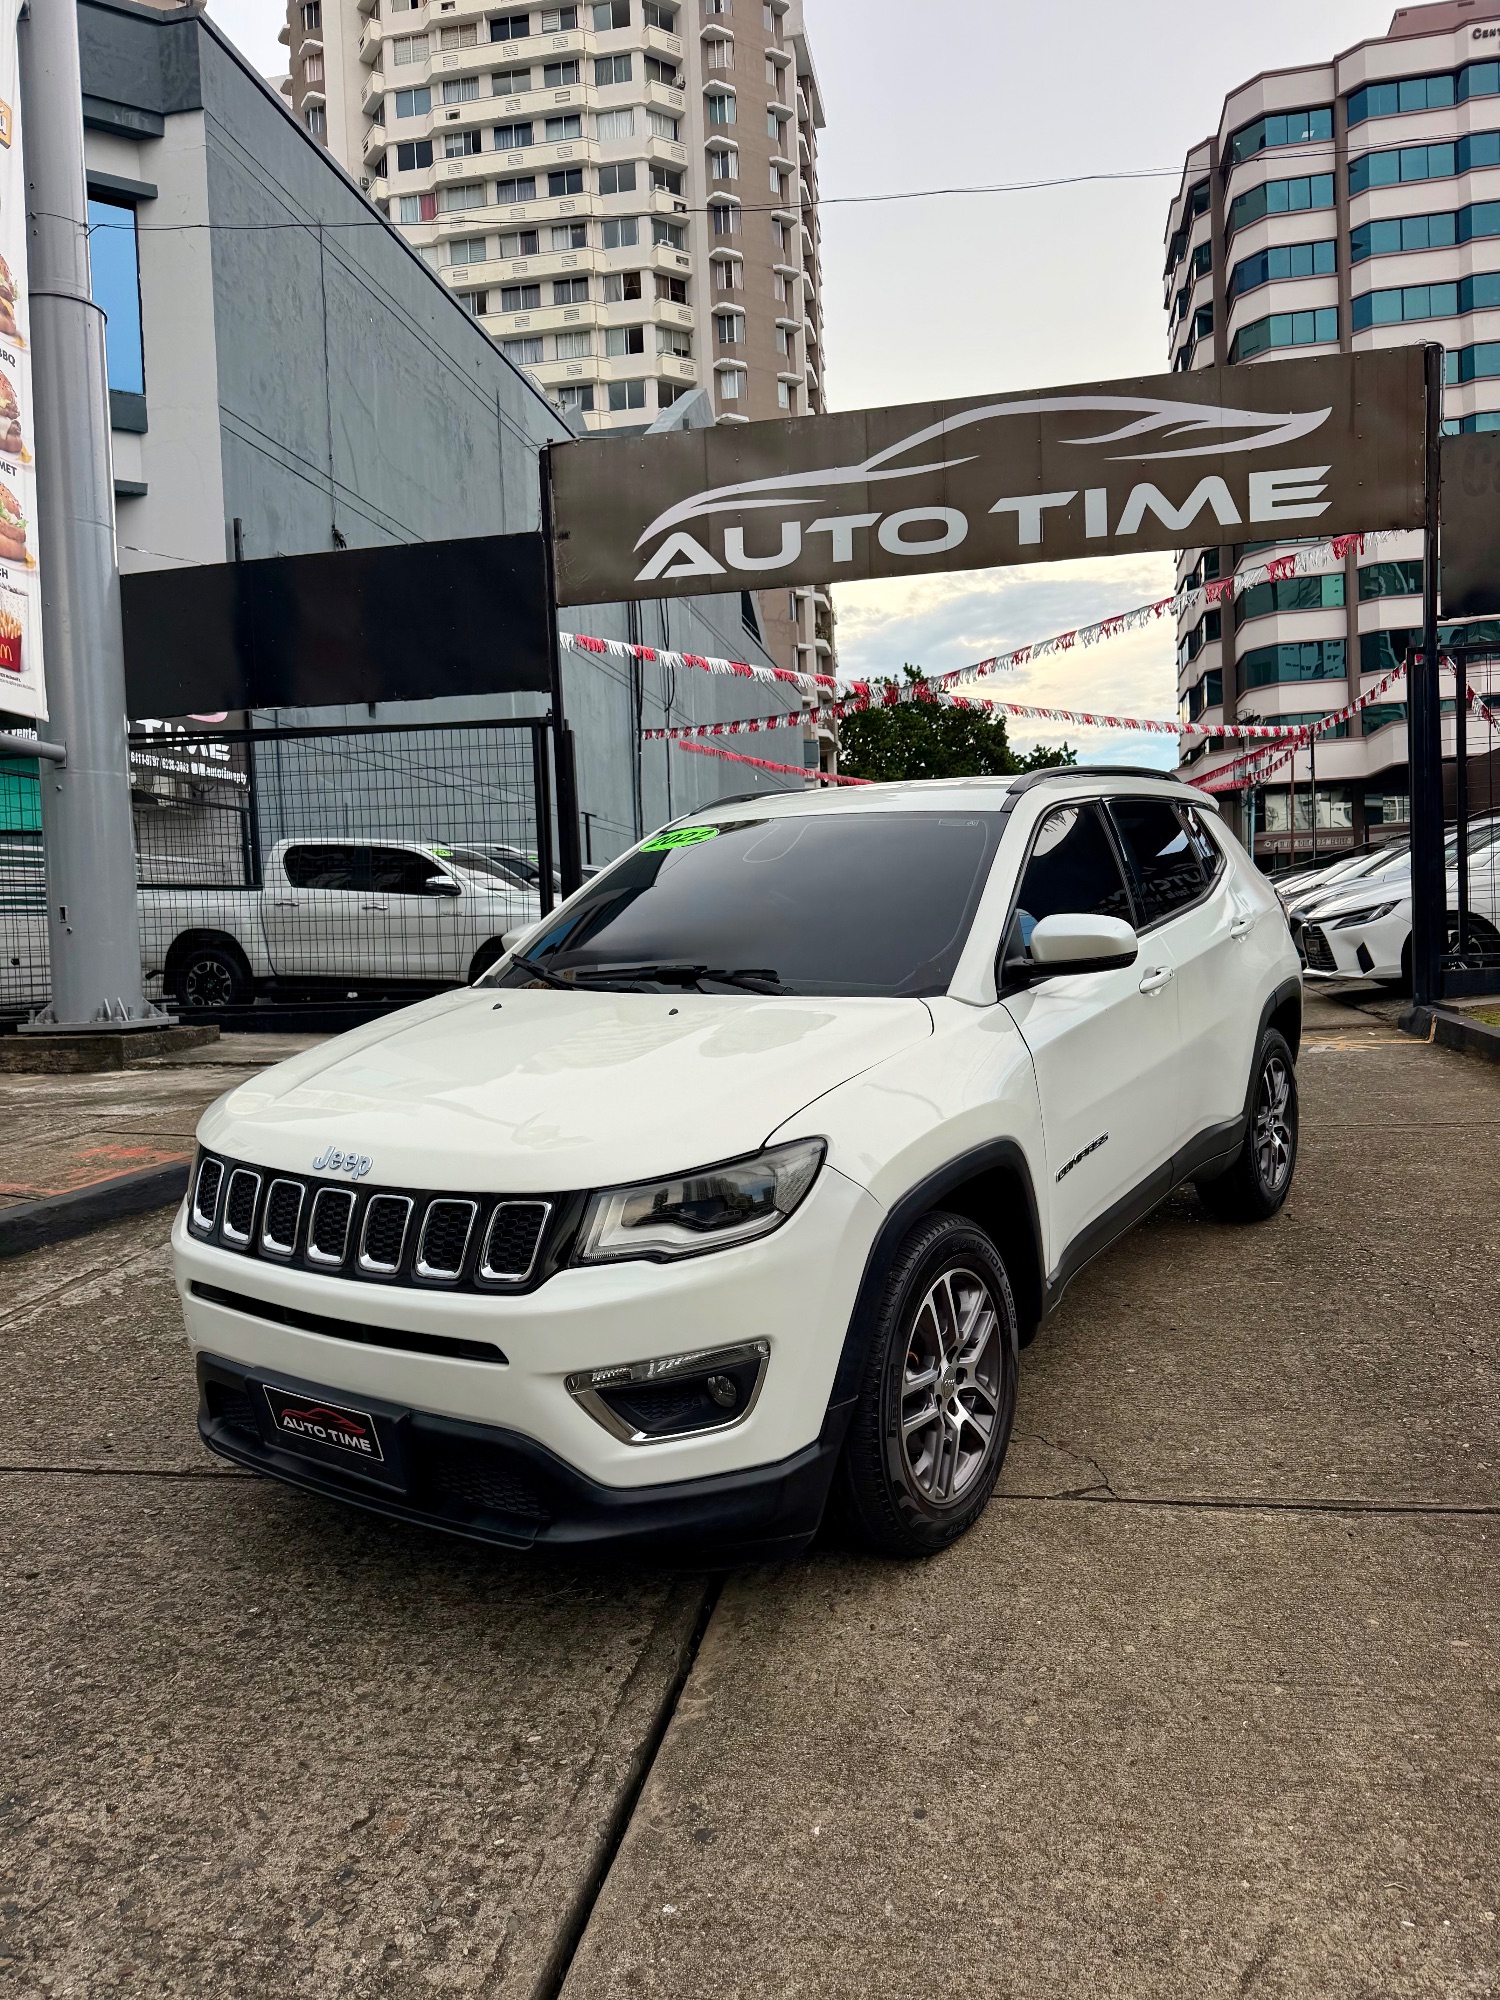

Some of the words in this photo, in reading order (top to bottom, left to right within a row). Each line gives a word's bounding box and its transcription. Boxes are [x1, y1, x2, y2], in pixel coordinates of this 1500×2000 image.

[634, 506, 969, 582] AUTO
[987, 464, 1333, 546] TIME
[642, 829, 716, 850] 2022
[312, 1145, 374, 1181] Jeep
[283, 1415, 327, 1438] AUTO
[327, 1429, 372, 1452] TIME
